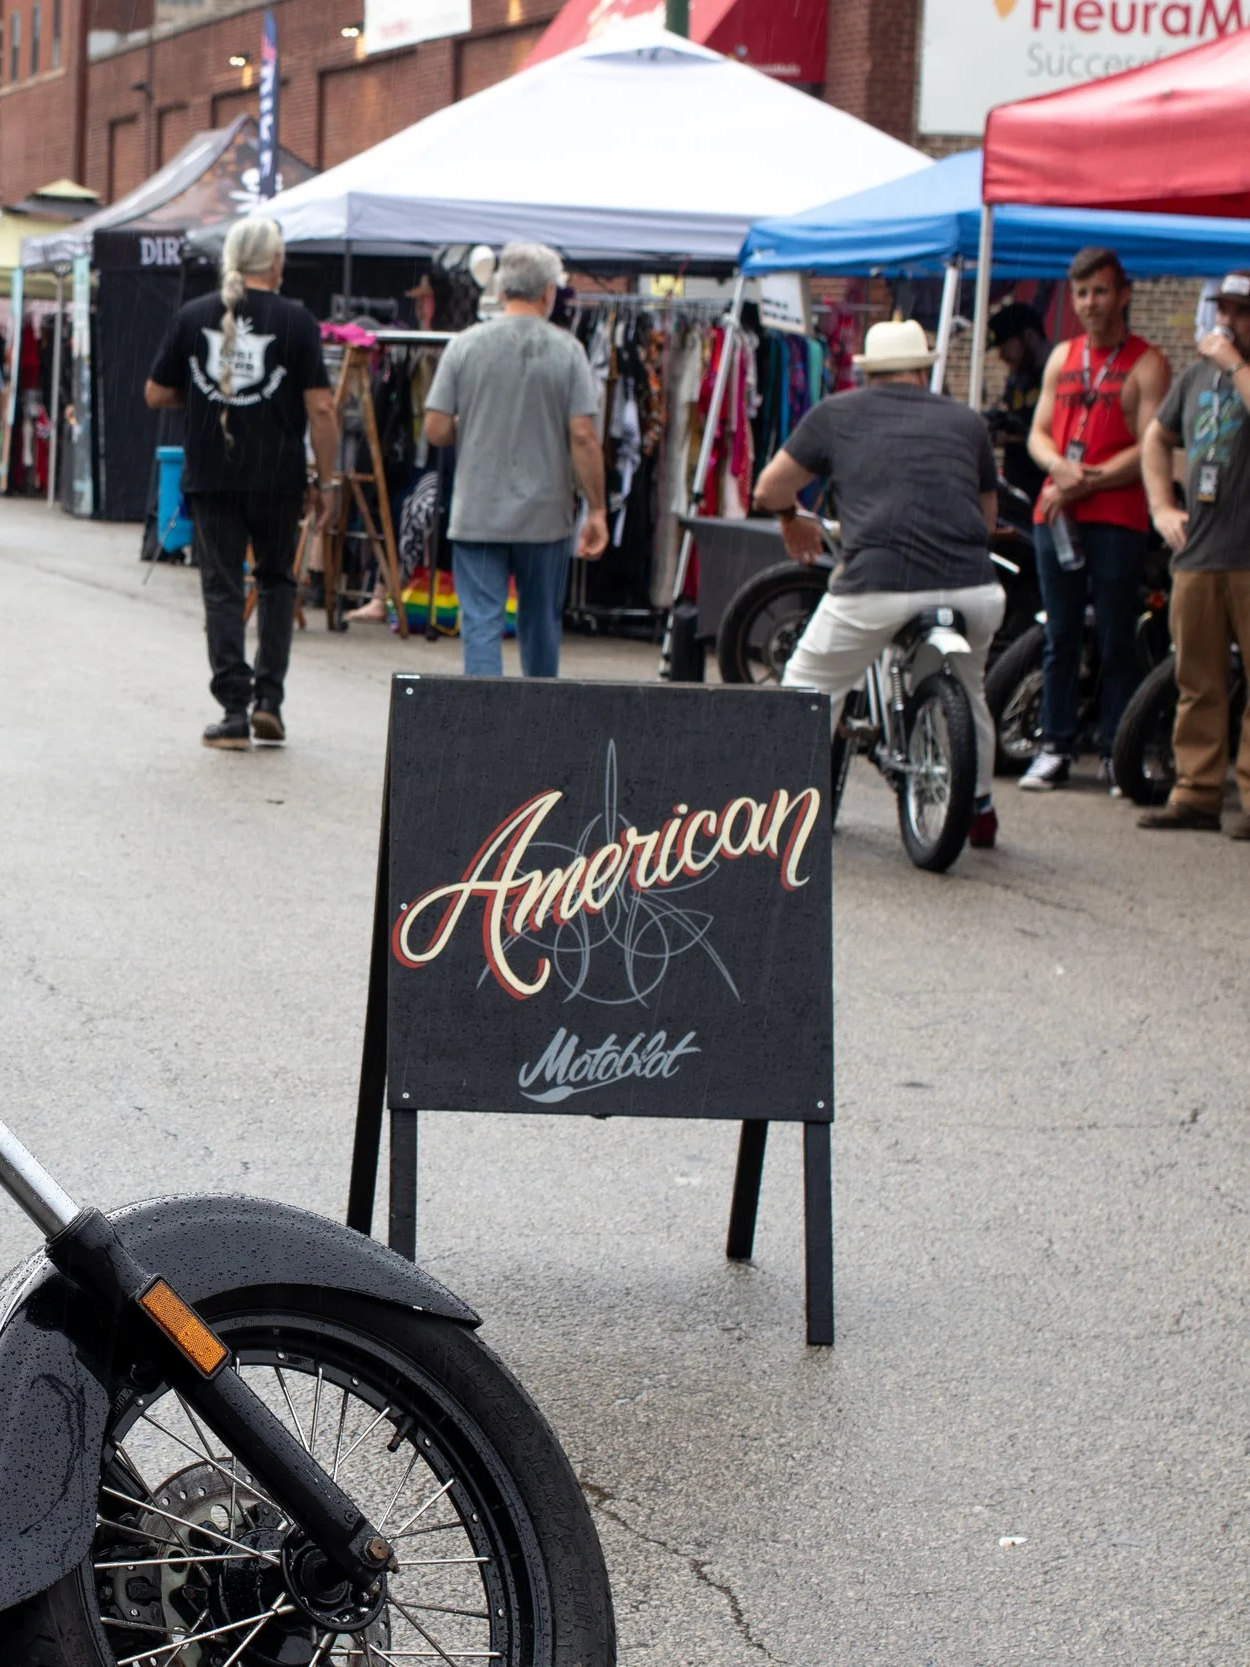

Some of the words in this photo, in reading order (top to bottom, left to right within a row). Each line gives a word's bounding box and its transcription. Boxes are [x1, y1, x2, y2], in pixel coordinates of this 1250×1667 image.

[1031, 0, 1250, 37] FleuraM
[141, 236, 186, 265] DIR
[393, 788, 820, 999] American
[518, 1026, 702, 1103] Motoblot
